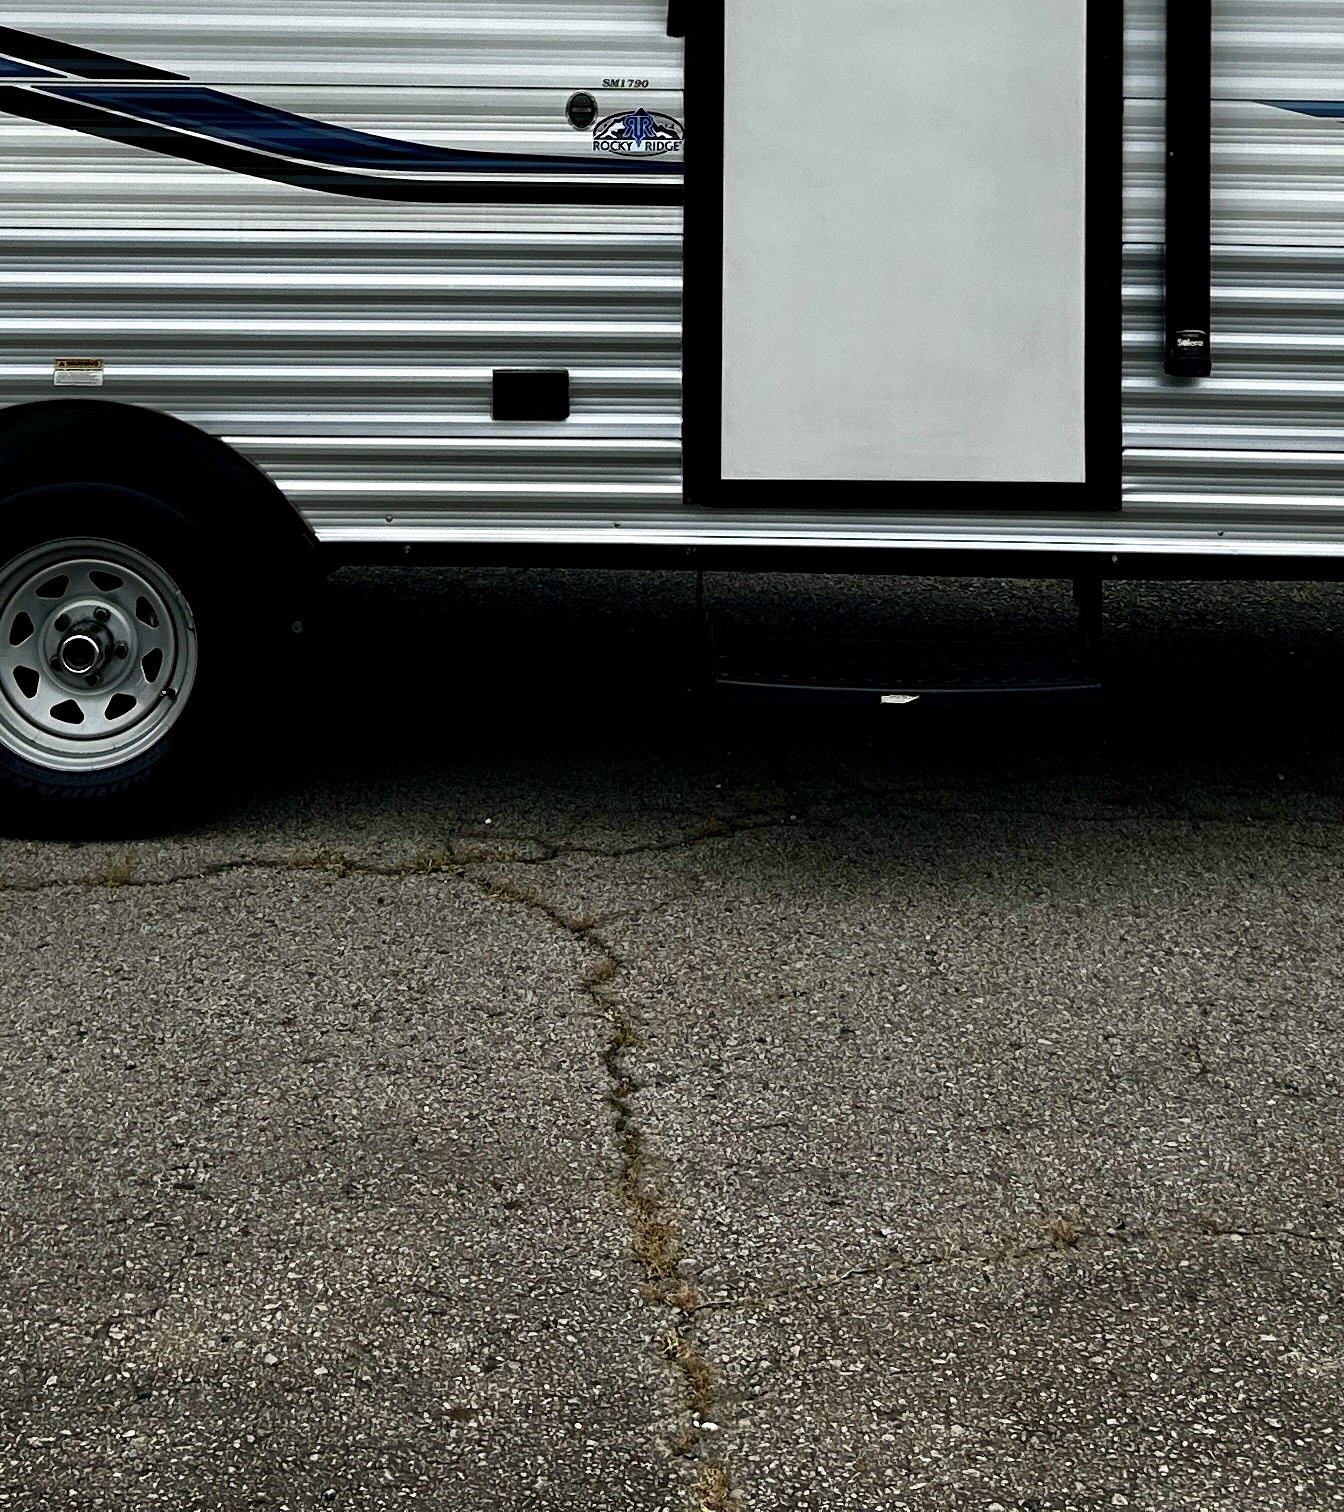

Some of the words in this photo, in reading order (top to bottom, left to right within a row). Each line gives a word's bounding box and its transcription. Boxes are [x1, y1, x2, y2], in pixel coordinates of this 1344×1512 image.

[601, 78, 649, 88] SM1790
[592, 140, 633, 152] ROCKY
[645, 140, 680, 152] RIDGE
